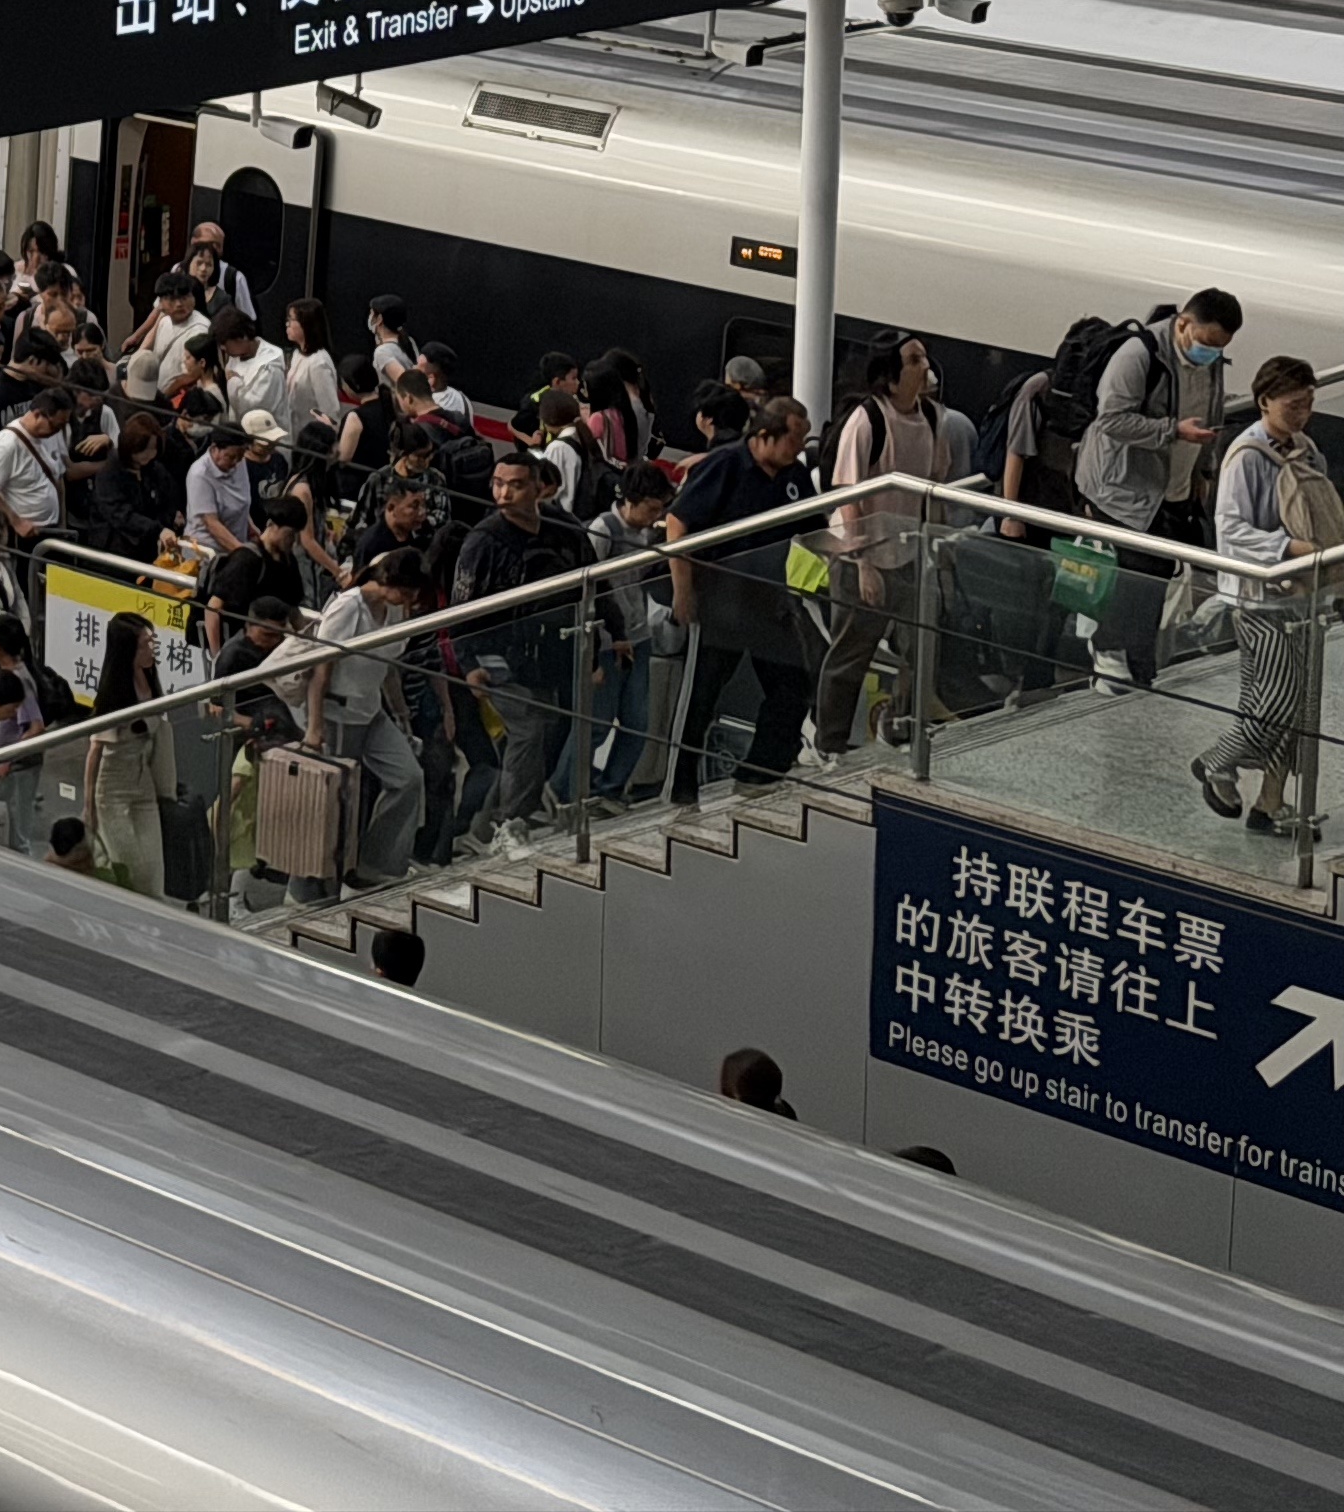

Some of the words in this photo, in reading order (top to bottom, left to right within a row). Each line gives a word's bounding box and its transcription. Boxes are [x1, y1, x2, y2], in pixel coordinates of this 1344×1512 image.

[294, 20, 337, 55] Exit
[343, 14, 360, 46] &
[366, 0, 459, 42] Transfer
[895, 894, 1218, 1040] 的旅客请往上
[953, 846, 1226, 974] 持联程车票
[895, 960, 1101, 1067] 中转换乘
[889, 1020, 969, 1071] Please
[974, 1055, 1004, 1084] go
[1010, 1066, 1040, 1099] up
[1045, 1075, 1101, 1114] stair
[1105, 1092, 1129, 1125] to
[1134, 1106, 1234, 1158] transfer
[1236, 1134, 1274, 1170] for
[1279, 1149, 1344, 1199] trains
